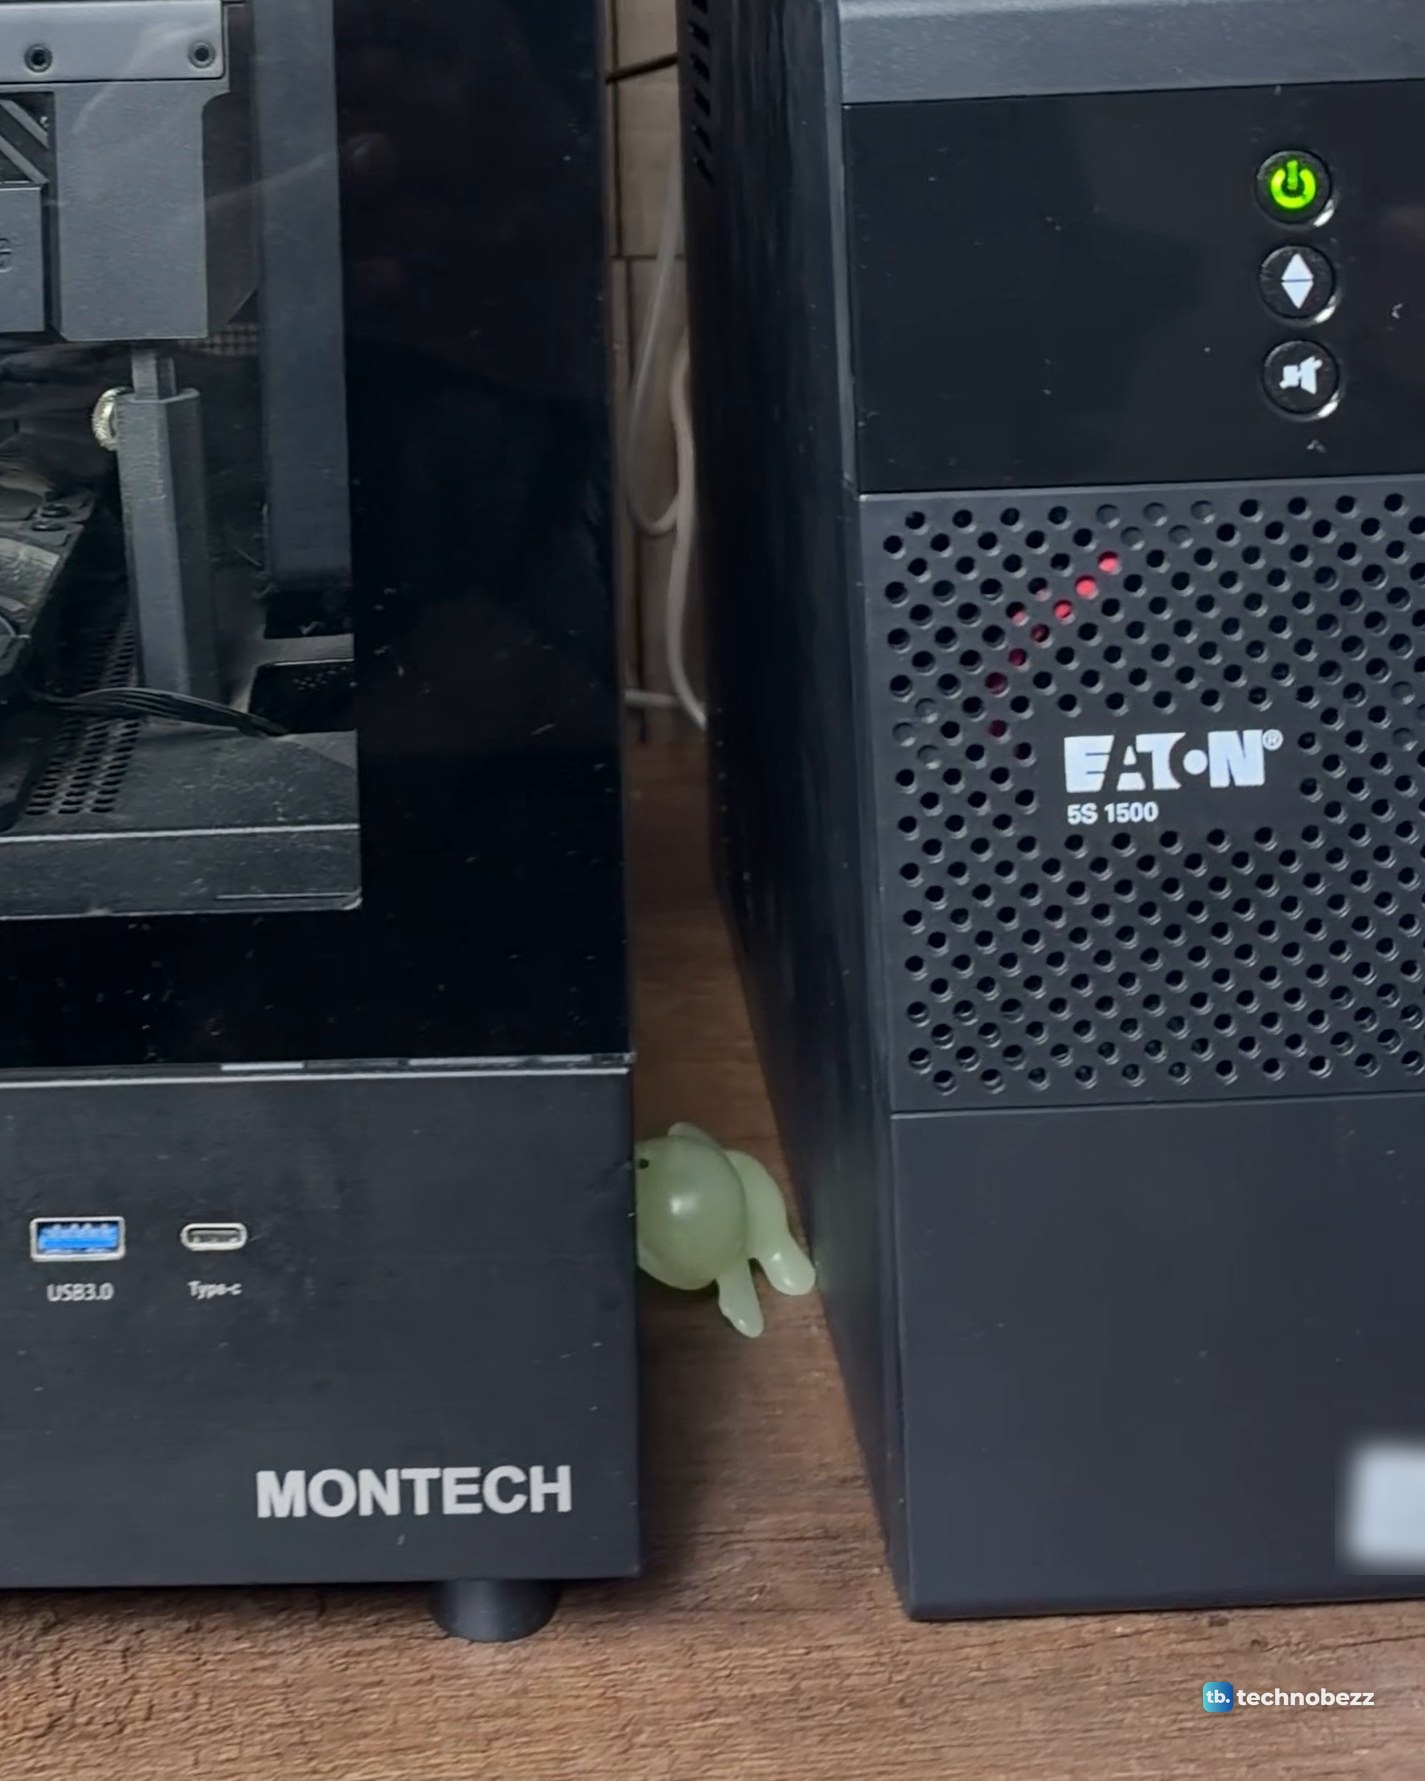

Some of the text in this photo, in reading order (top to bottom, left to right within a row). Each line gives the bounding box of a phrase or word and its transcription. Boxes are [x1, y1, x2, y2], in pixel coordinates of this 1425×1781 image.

[1067, 801, 1159, 825] 5S 1500
[47, 1282, 114, 1301] USB3.0
[256, 1465, 572, 1518] MONTECH
